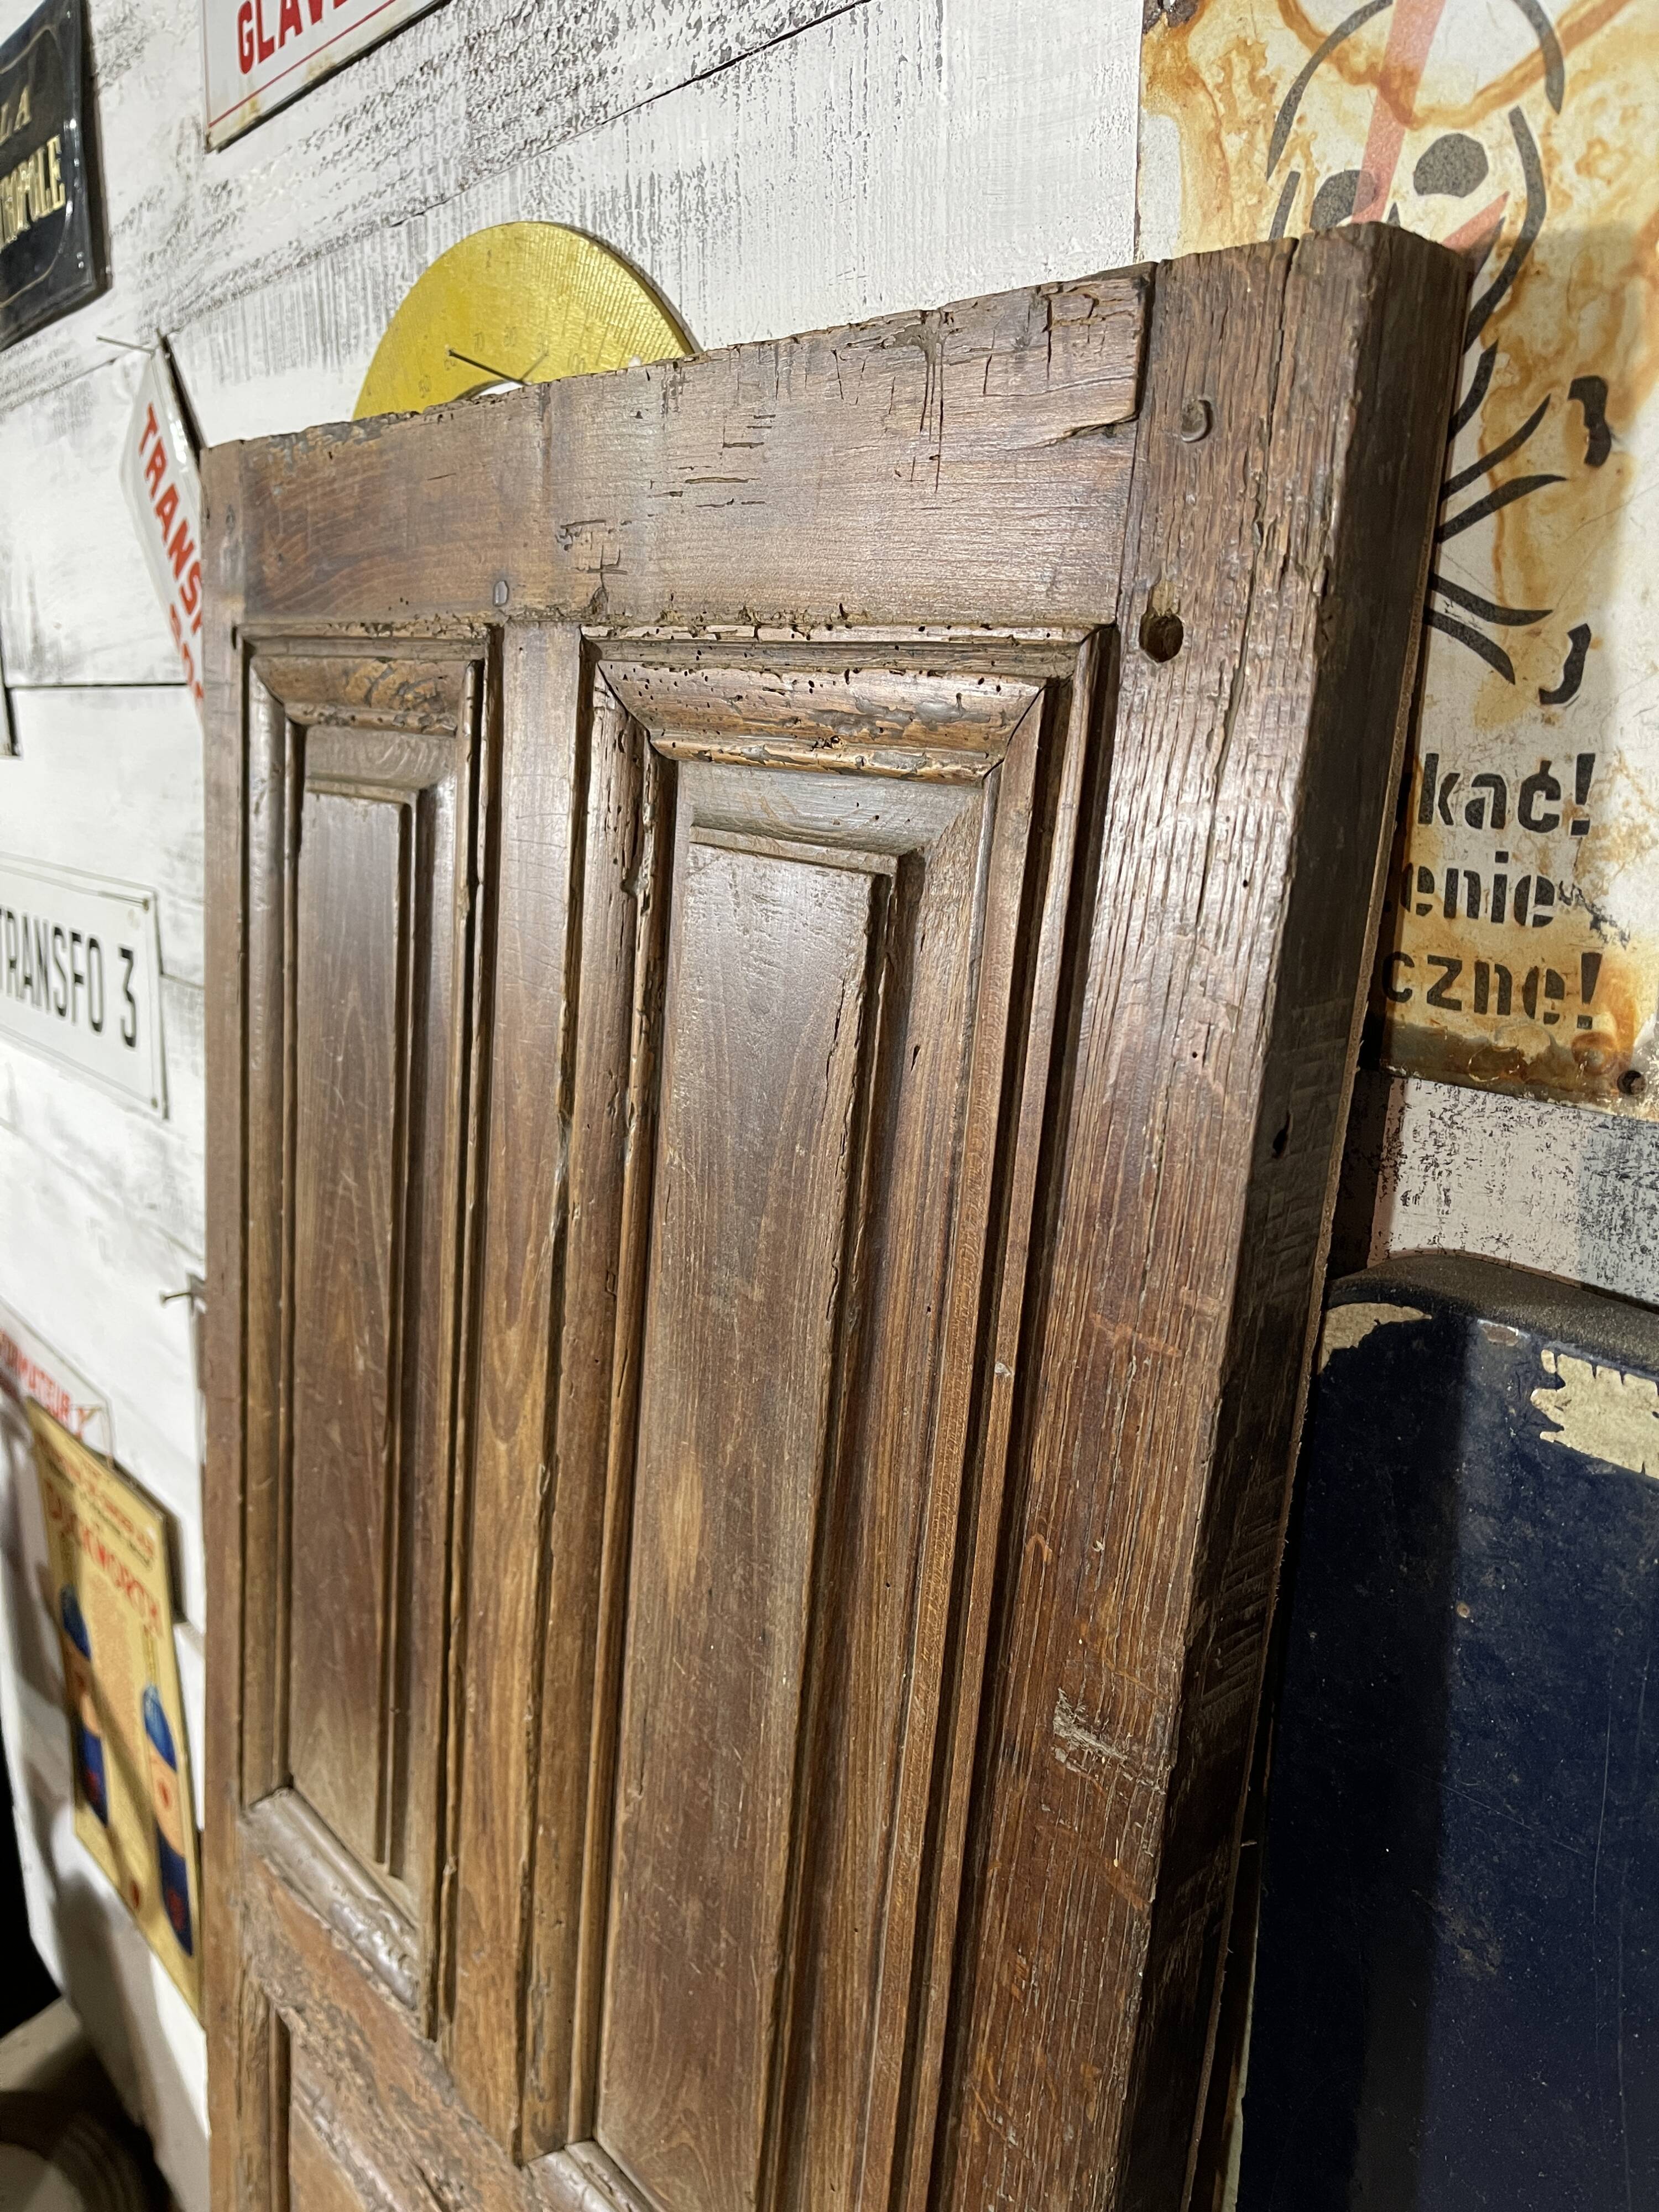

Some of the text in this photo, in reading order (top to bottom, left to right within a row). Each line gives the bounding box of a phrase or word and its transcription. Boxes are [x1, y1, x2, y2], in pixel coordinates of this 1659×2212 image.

[237, 0, 347, 75] GLA
[0, 907, 136, 1048] RANSFO 3
[1383, 951, 1603, 1030] czne!
